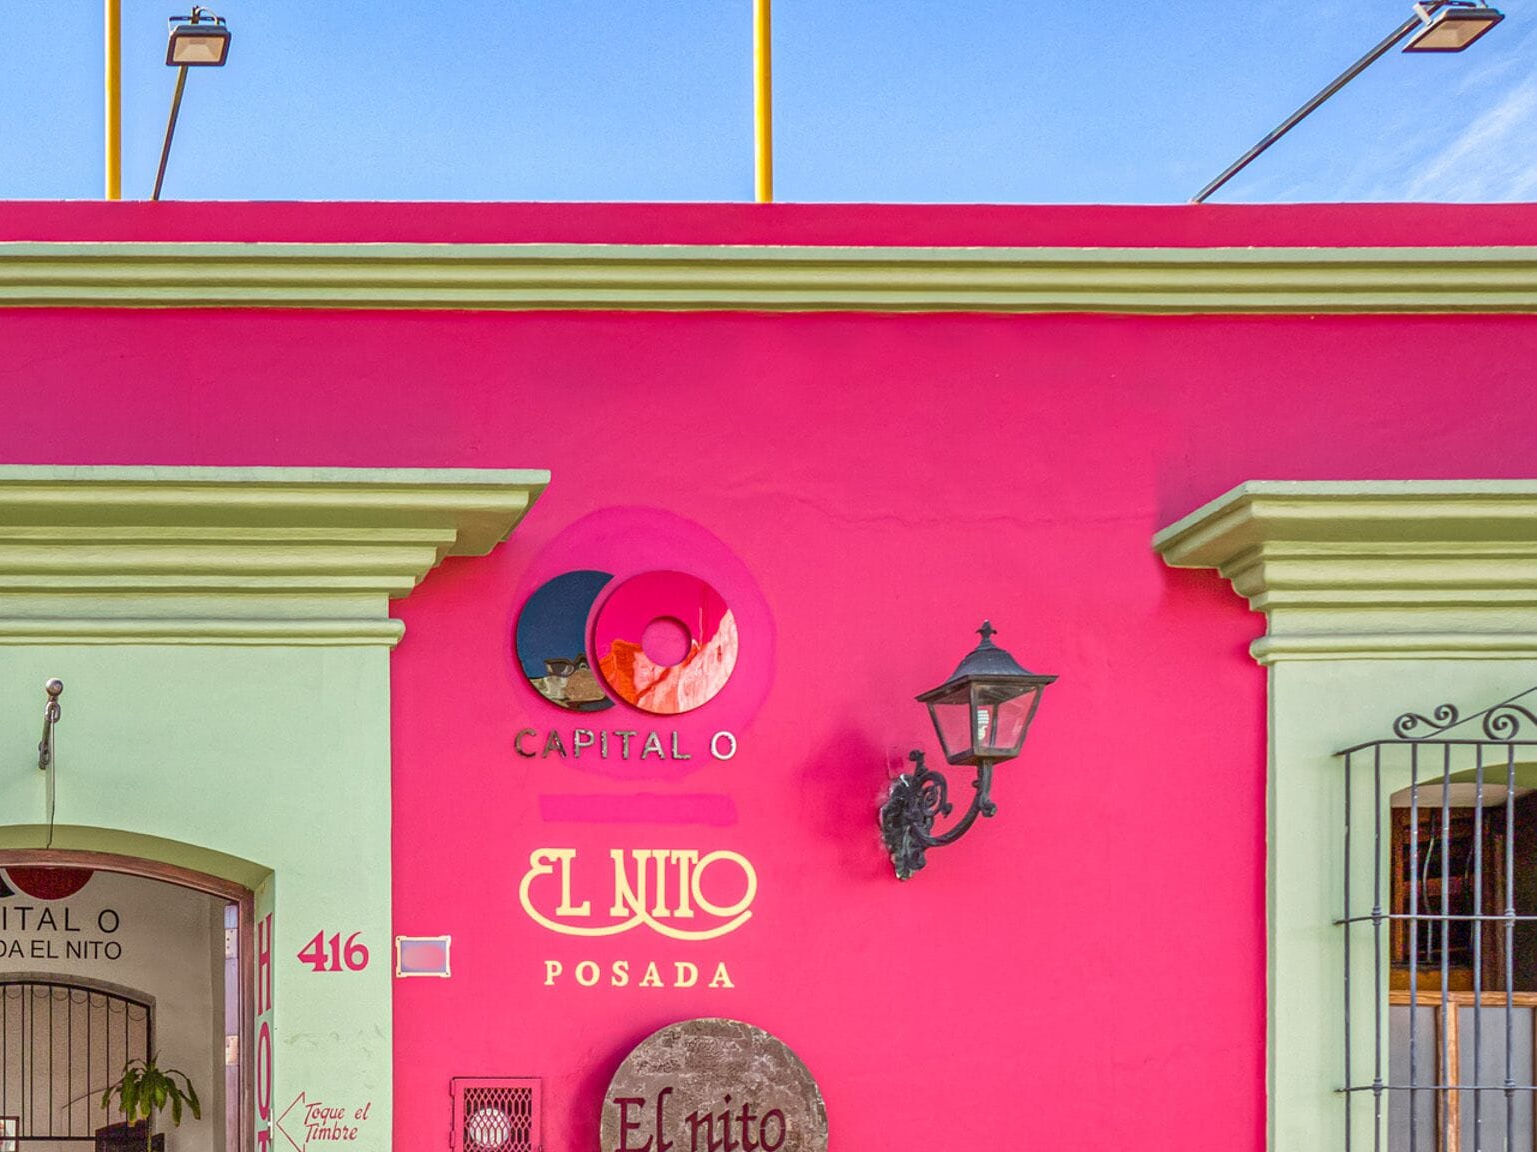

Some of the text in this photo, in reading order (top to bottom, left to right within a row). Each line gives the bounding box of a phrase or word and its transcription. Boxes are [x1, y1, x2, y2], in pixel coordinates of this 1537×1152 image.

[514, 729, 737, 760] CAPITAL O
[519, 847, 758, 941] EL NITO
[98, 909, 120, 933] O
[31, 940, 59, 959] EL
[66, 941, 122, 960] NITO
[297, 930, 369, 972] 416
[543, 960, 735, 988] POSADA
[304, 1102, 371, 1126] Toque el
[305, 1120, 358, 1143] Timbre
